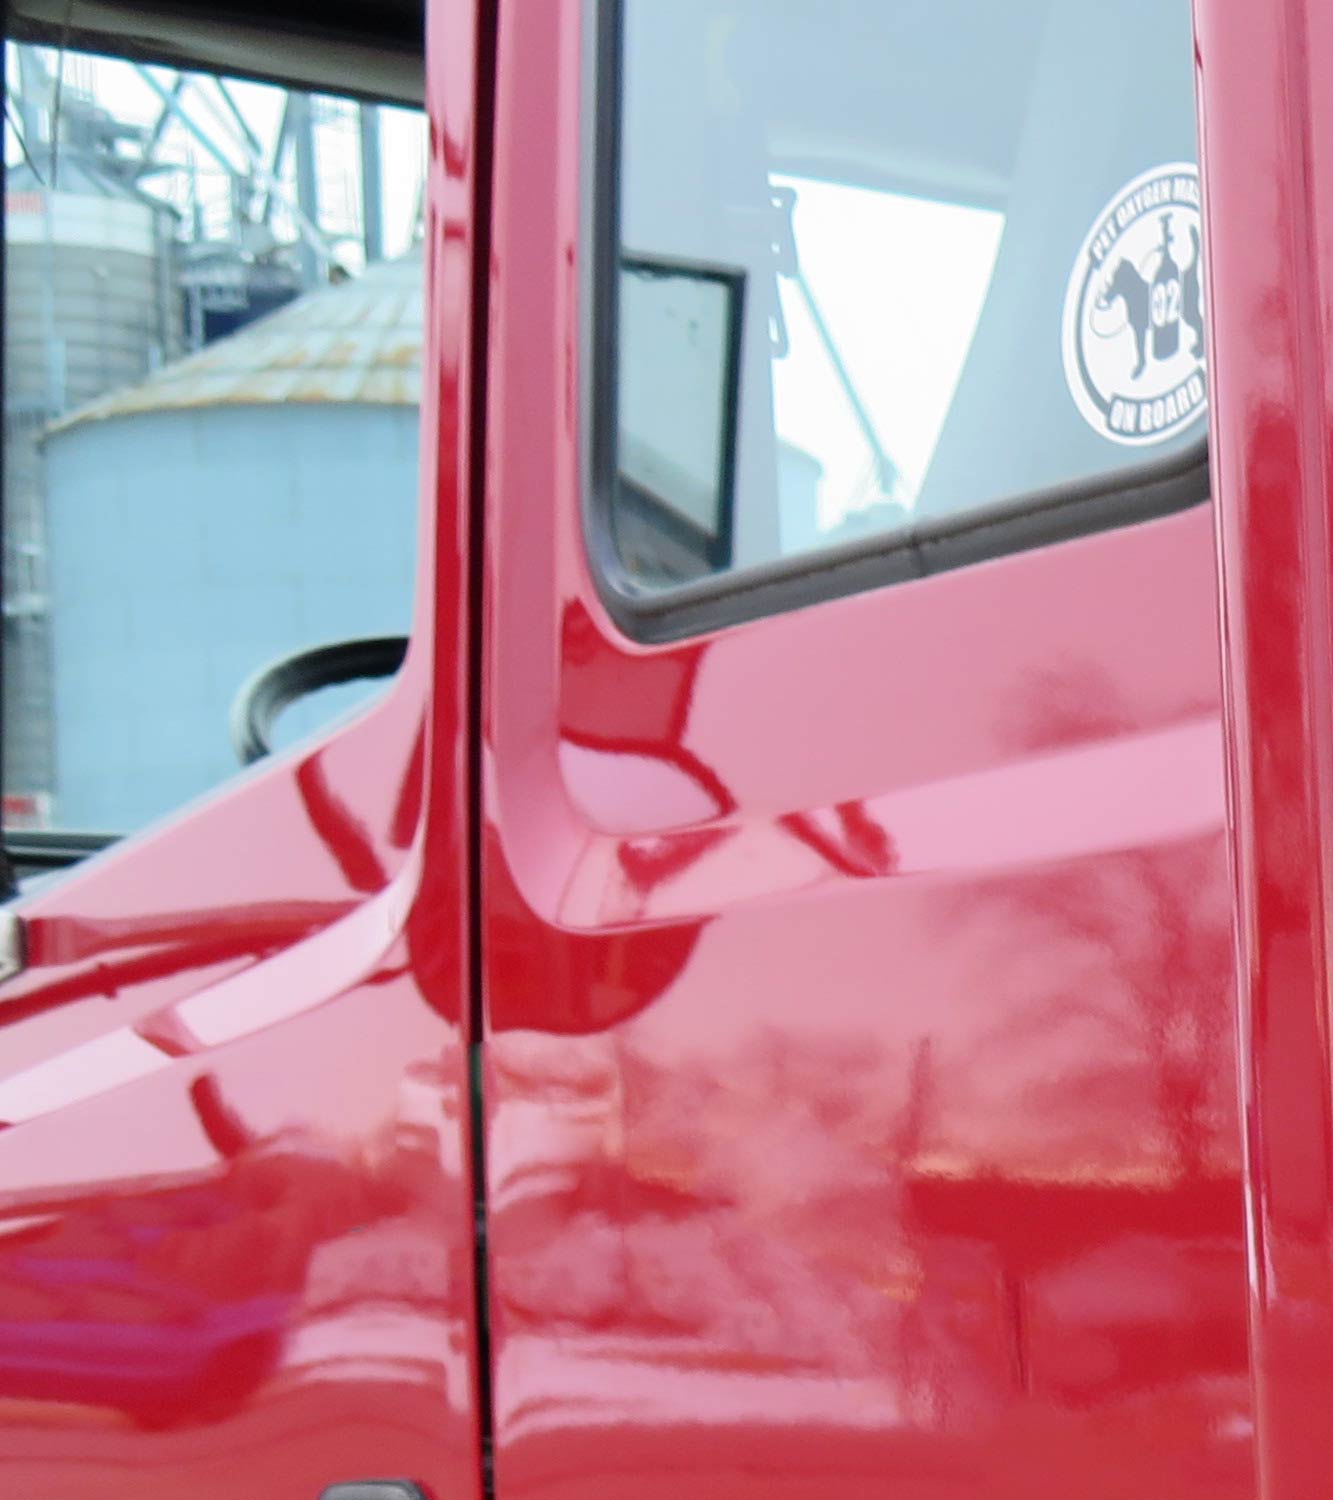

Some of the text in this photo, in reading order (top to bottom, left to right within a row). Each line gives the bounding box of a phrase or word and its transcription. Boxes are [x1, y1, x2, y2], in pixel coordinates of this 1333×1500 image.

[1092, 217, 1117, 261] PET
[1116, 180, 1171, 229] OXYGEN
[1110, 373, 1204, 432] ON BOARD
